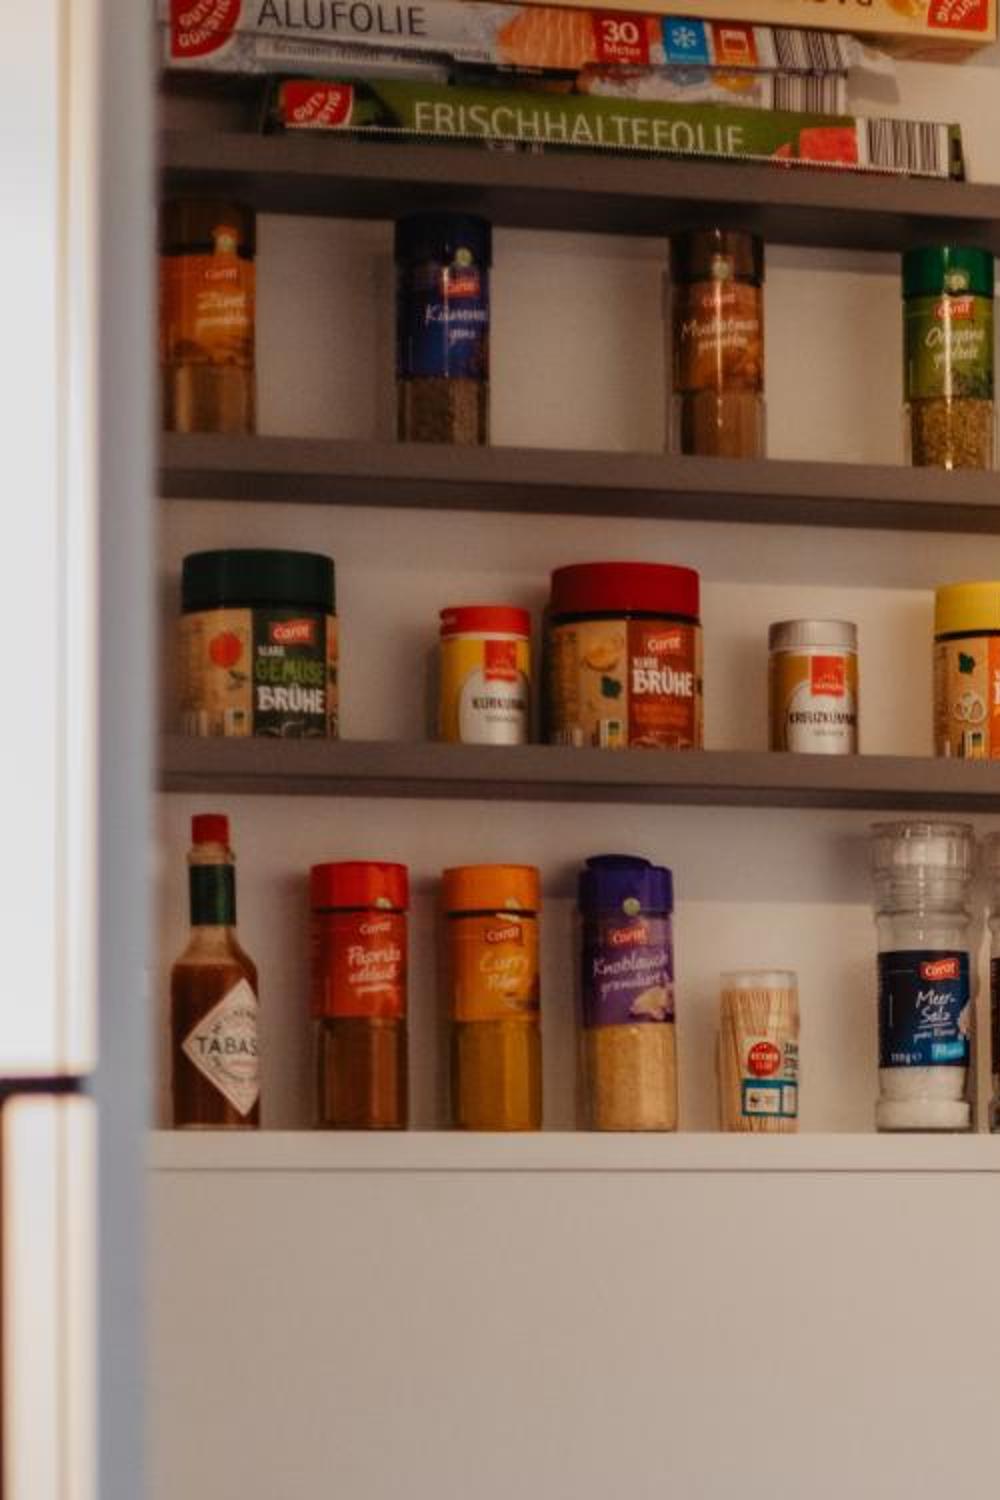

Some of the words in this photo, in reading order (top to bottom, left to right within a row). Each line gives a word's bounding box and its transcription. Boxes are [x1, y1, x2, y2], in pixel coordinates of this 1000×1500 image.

[256, 0, 428, 37] ALUFOLIE
[602, 19, 639, 45] 30
[414, 101, 744, 154] FRISCHHALTEFOLIE
[632, 665, 694, 697] BRÜHE
[257, 684, 325, 713] BRÜHE
